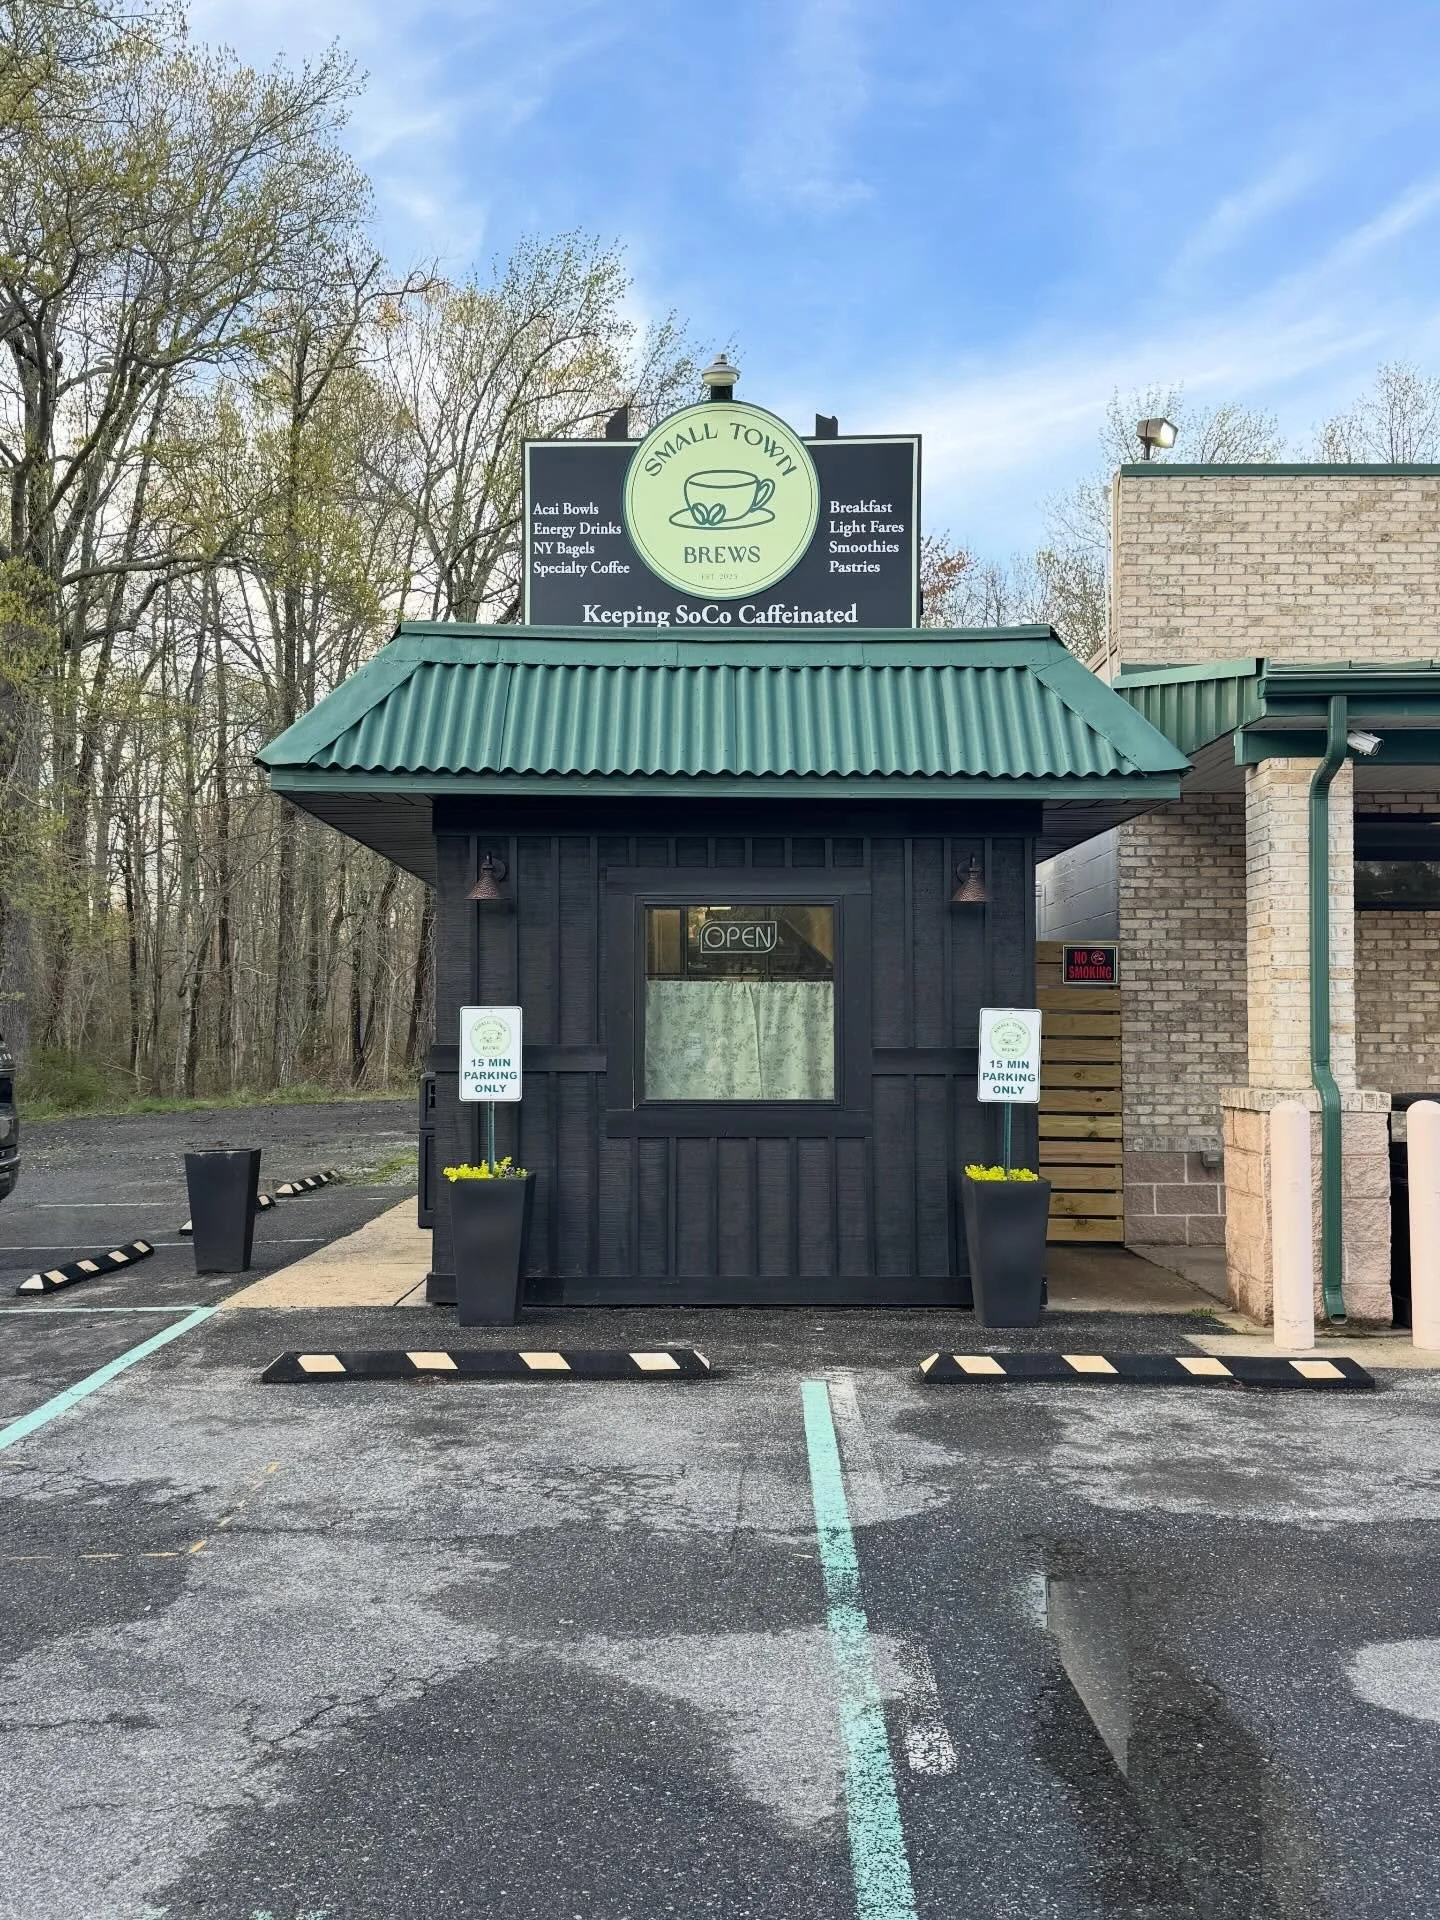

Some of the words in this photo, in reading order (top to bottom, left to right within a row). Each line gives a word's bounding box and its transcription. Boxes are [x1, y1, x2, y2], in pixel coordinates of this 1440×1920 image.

[645, 423, 718, 476] SMALL
[730, 422, 797, 476] TOWN
[533, 503, 559, 515] Acai
[563, 502, 599, 515] Bowls
[830, 500, 893, 513] Breakfast
[533, 522, 576, 539] Energy
[580, 521, 622, 535] Drinks
[830, 520, 866, 537] Light
[870, 520, 905, 533] Fares
[533, 542, 554, 555] NY
[557, 541, 595, 558] Bagels
[829, 540, 900, 553] Smoothies
[684, 545, 761, 564] BREWS
[533, 561, 588, 577] Specialty
[591, 560, 630, 574] Coffee
[829, 560, 881, 573] Pastries
[582, 604, 671, 628] Keeping
[675, 604, 732, 624] SoCo
[738, 603, 858, 624] Caffeinated
[705, 926, 771, 948] OPEN
[1074, 951, 1088, 965] NO
[1069, 966, 1112, 979] SMOKING
[471, 1058, 485, 1067] 15
[488, 1058, 511, 1067] MIN
[990, 1060, 1003, 1069] 15
[1007, 1060, 1030, 1069] MIN
[464, 1071, 518, 1080] PARKING
[982, 1072, 1036, 1082] PARKING
[475, 1084, 507, 1093] ONLY
[992, 1085, 1025, 1095] ONLY
